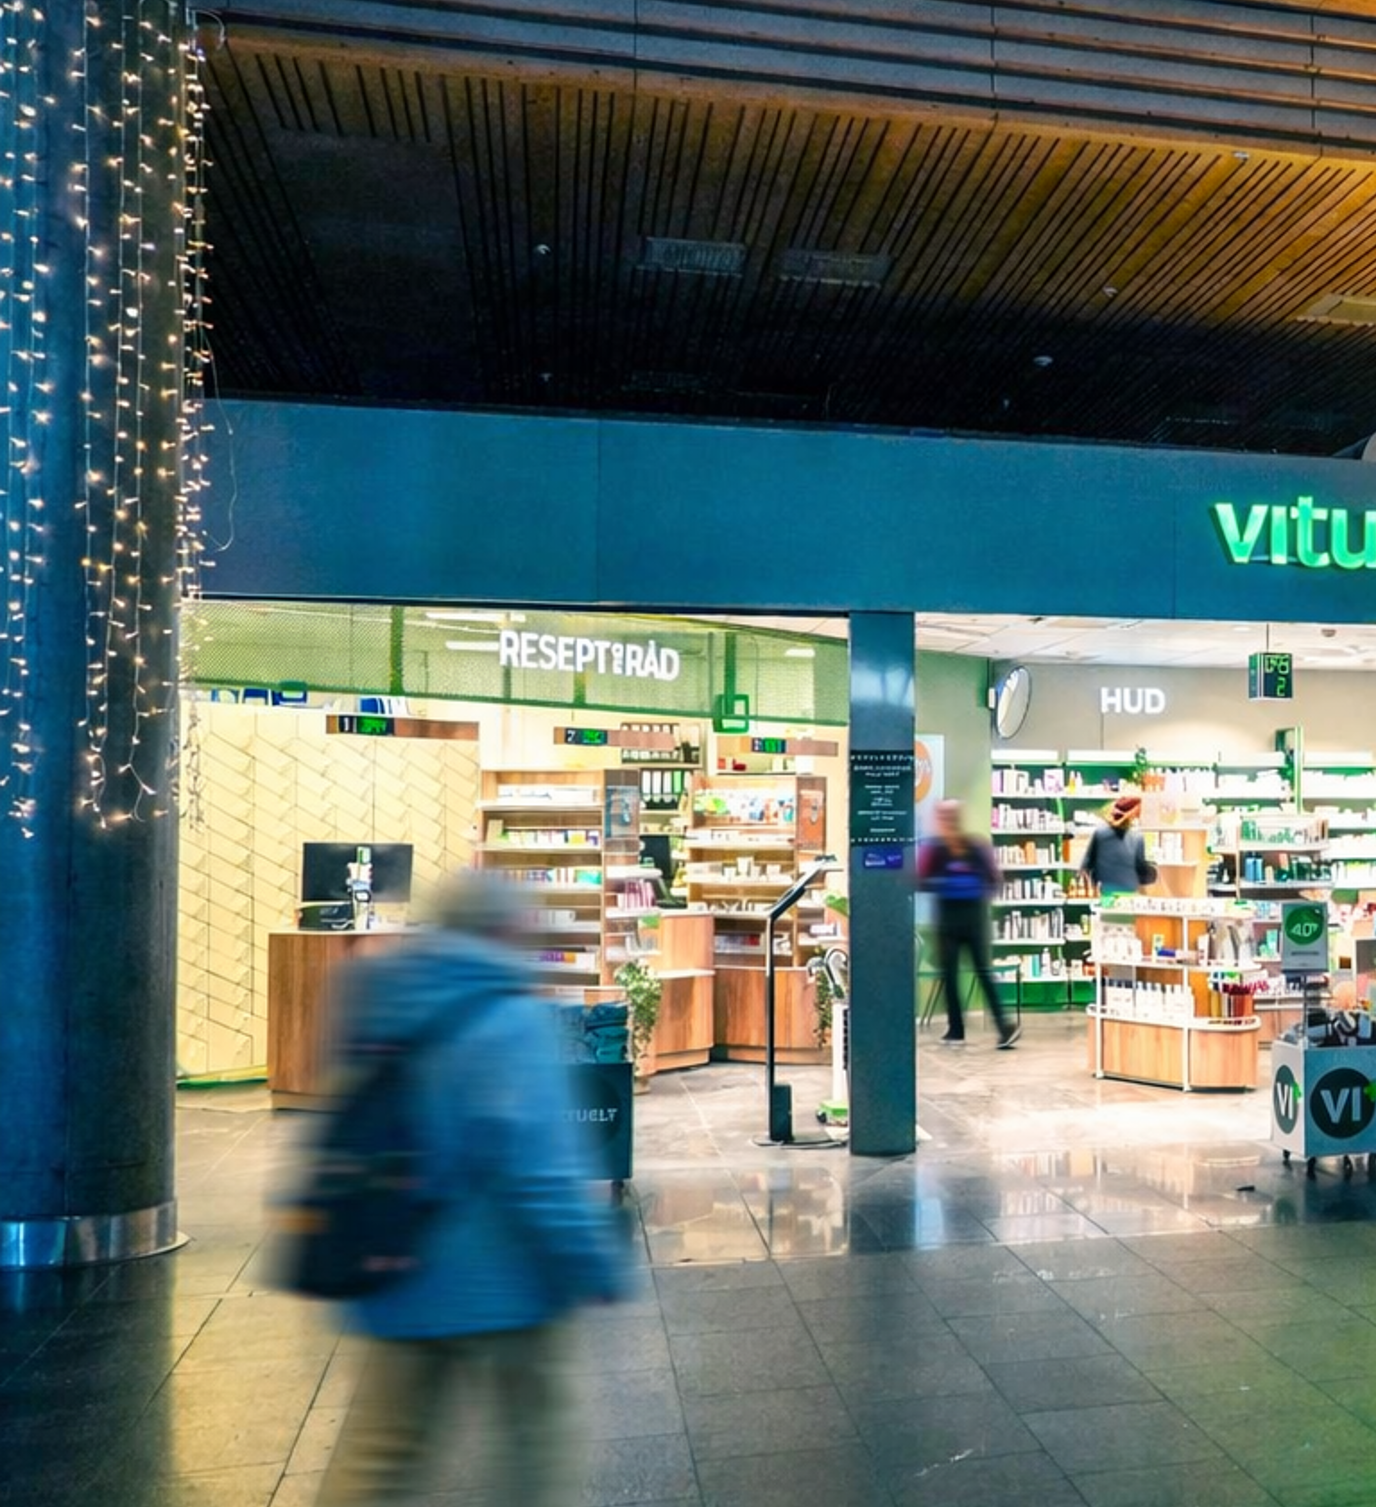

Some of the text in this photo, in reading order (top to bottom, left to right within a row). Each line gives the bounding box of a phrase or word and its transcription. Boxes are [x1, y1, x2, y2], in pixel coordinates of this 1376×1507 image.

[499, 629, 610, 675] RESEPT
[624, 640, 680, 682] RÅD
[1101, 687, 1166, 714] HUD
